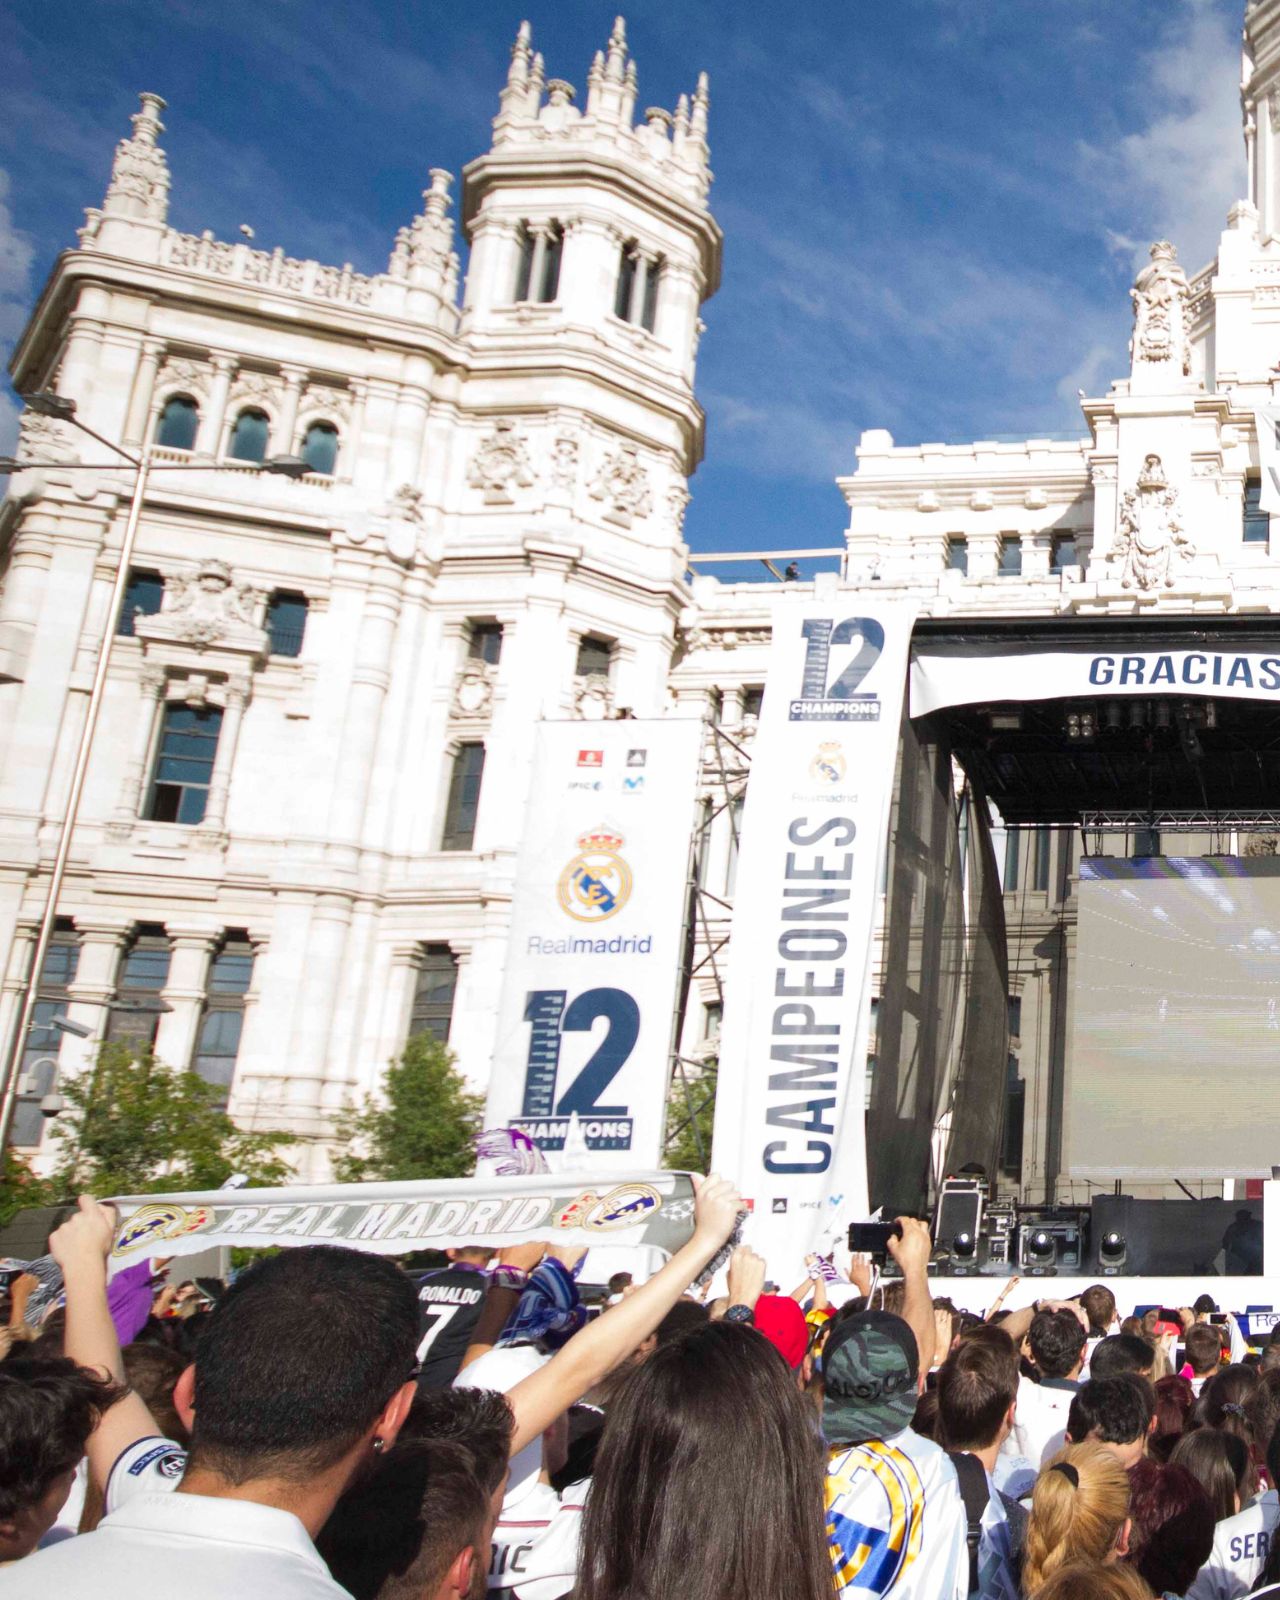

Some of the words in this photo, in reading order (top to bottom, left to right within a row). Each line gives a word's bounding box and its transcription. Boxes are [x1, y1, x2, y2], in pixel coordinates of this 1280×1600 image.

[800, 616, 885, 700] 12
[790, 702, 880, 714] CHAMPIONS
[527, 935, 652, 955] Realmadrid
[761, 816, 857, 1175] CAMPEONES
[522, 986, 641, 1117] 12
[510, 1122, 631, 1139] HAMIONS
[213, 1204, 344, 1236] REAL
[347, 1196, 555, 1240] MADRID
[418, 1285, 482, 1305] RONALDO
[415, 1303, 461, 1363] 7
